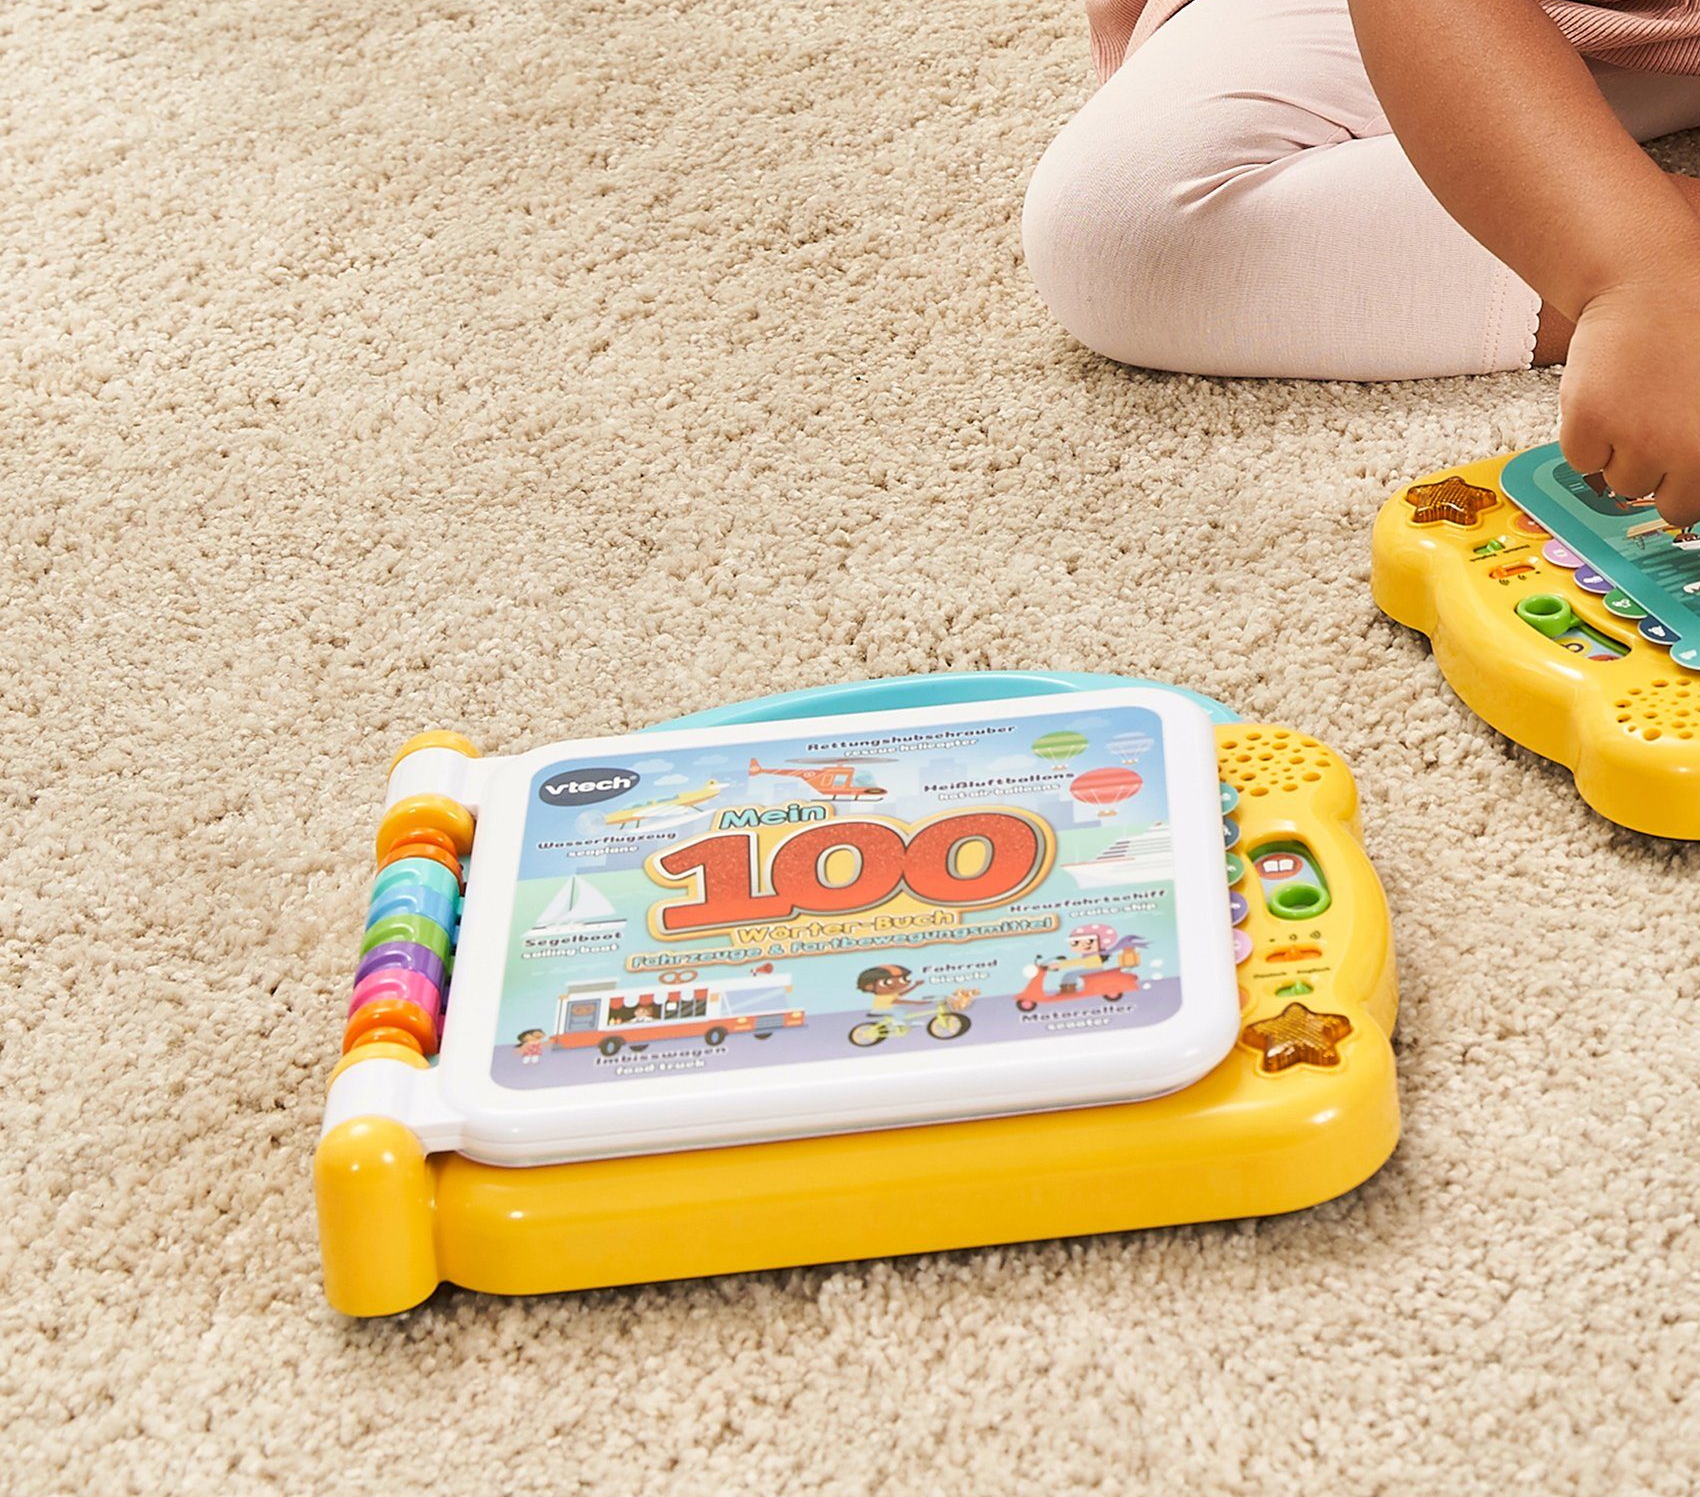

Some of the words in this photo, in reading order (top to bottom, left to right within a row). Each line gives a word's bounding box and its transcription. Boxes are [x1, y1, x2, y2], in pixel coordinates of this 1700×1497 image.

[807, 725, 1017, 751] Rettungshubschrauber
[899, 738, 979, 753] helicopter
[544, 776, 632, 796] vtech
[924, 772, 1075, 792] Heißluftballons
[718, 803, 827, 830] Mein
[537, 832, 677, 850] Wasserflugzeug
[566, 845, 639, 858] seaplane
[657, 811, 1041, 933] 100
[1010, 890, 1167, 914] Kreuzfahrtschiff
[1069, 905, 1119, 918] cruise
[1121, 902, 1158, 915] ship
[525, 932, 622, 948] Segelboot
[632, 946, 763, 968] Fahrzeuge
[767, 944, 785, 956] &
[790, 917, 1053, 954] Fortbewegungsmittel
[520, 946, 577, 961] sailing
[579, 942, 619, 956] boat
[922, 959, 998, 975] Fahrrad
[1021, 1003, 1136, 1023] Motorroller
[596, 1046, 727, 1065] Imbisswagen
[615, 1062, 656, 1075] food
[659, 1057, 705, 1072] truck
